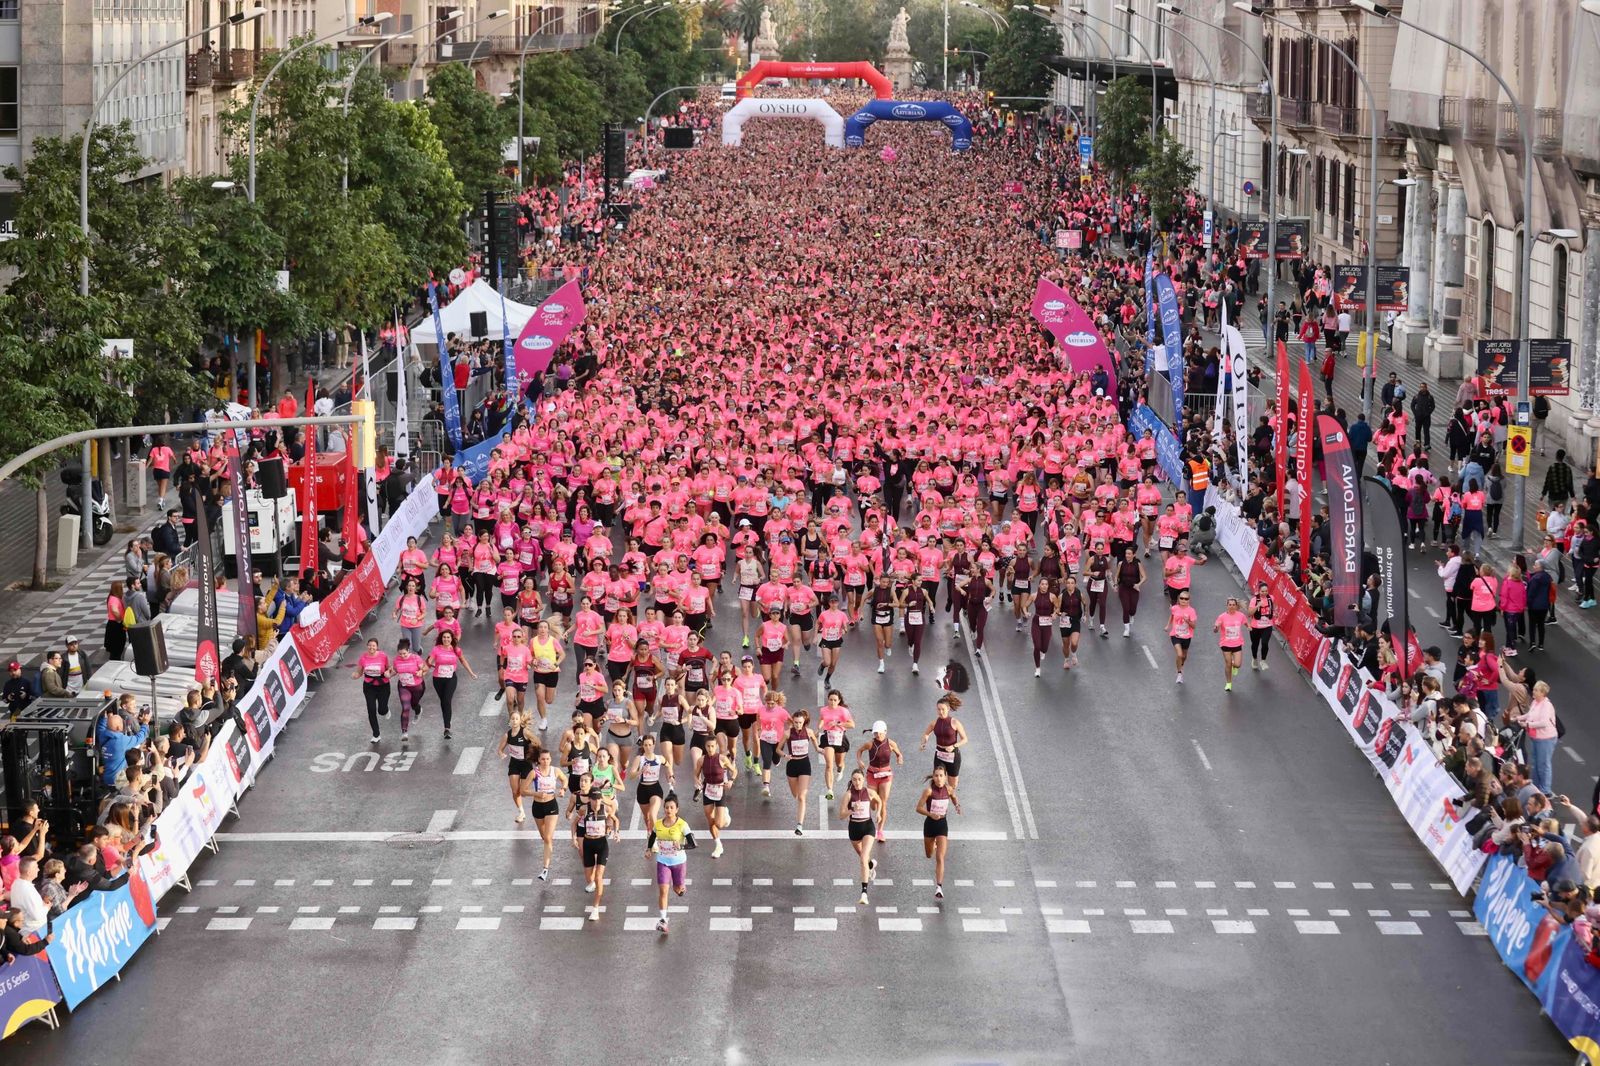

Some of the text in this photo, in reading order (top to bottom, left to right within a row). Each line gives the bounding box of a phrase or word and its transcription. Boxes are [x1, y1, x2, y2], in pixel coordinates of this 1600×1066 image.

[759, 103, 807, 114] OYSHO
[1204, 220, 1211, 234] P
[309, 751, 419, 773] BUS
[60, 892, 133, 991] Marlene
[6, 978, 13, 991] 6
[11, 970, 30, 988] Series
